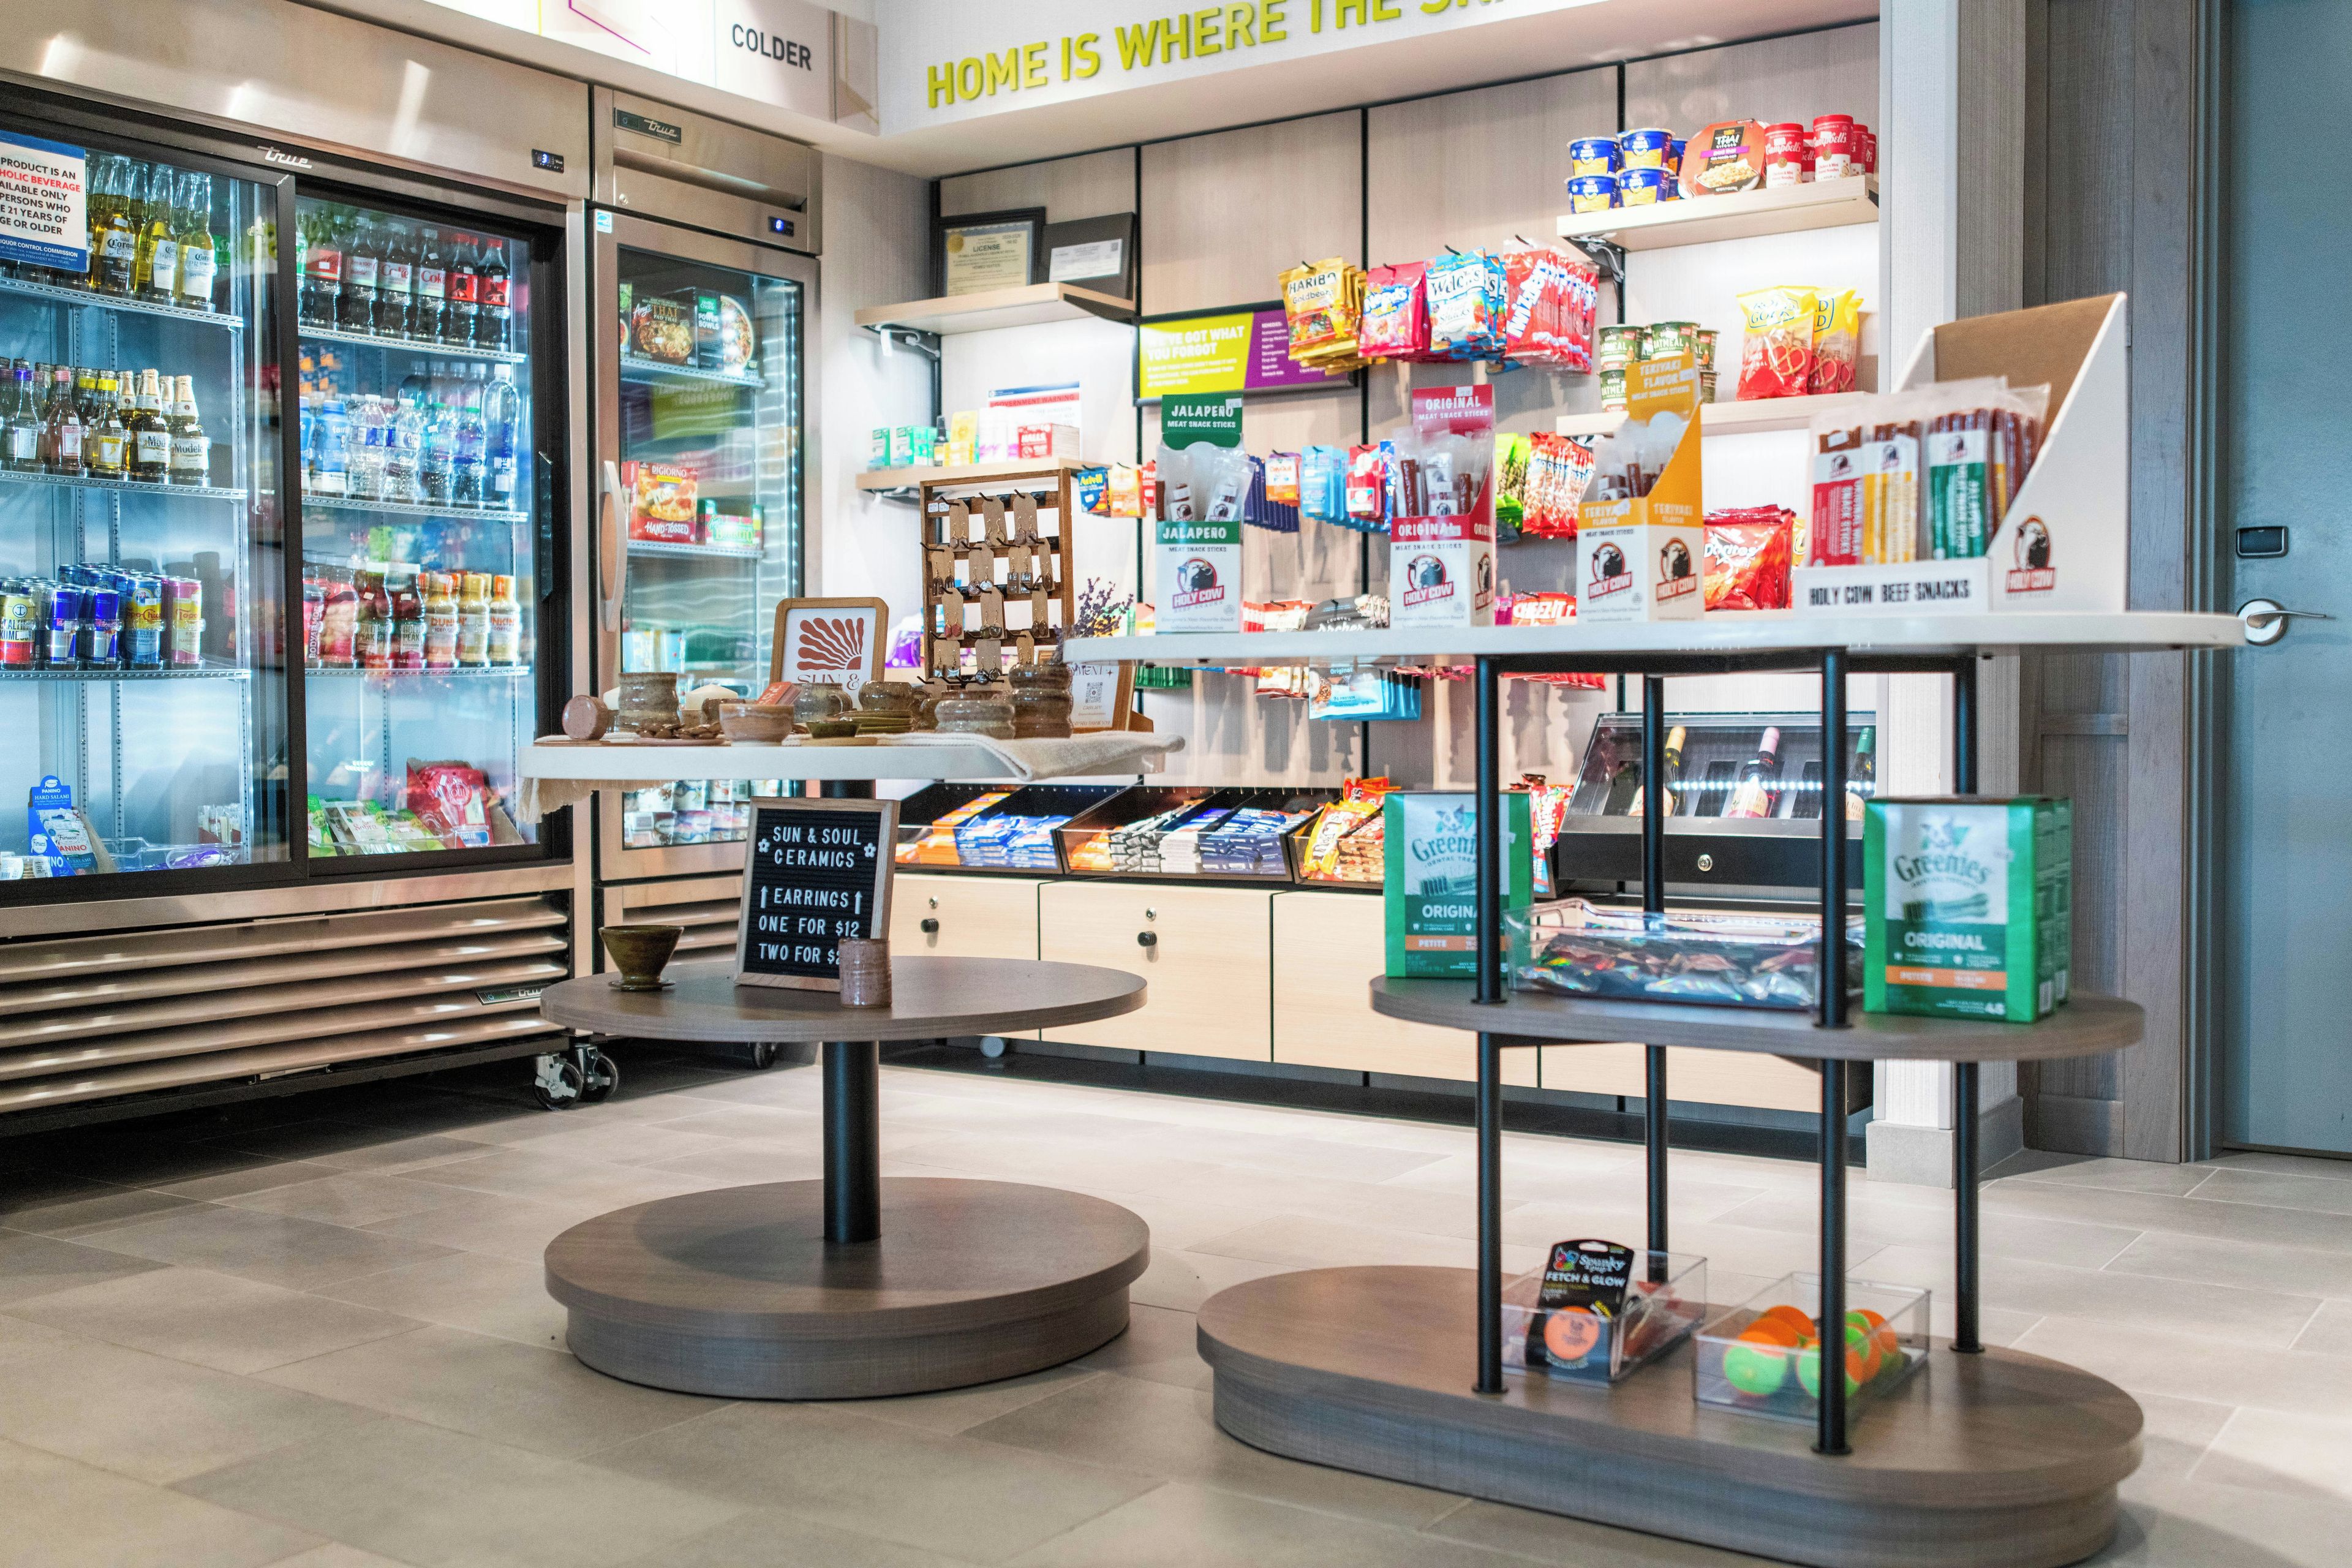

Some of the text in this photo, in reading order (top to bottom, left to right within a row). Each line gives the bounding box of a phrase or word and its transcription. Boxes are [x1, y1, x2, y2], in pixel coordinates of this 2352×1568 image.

[732, 23, 812, 72] COLDER
[927, 41, 1047, 108] HOME
[1060, 33, 1101, 81] IS
[1115, 2, 1287, 71] WHERE
[1715, 135, 1740, 145] THAI
[257, 145, 312, 169] true
[1, 157, 76, 179] PRODUCT IS AN
[31, 176, 80, 192] BEVERAGE
[0, 193, 70, 213] PERSONS WHO
[41, 189, 68, 201] ONLY
[20, 208, 52, 222] YEARS
[55, 215, 67, 224] OF
[14, 219, 28, 229] OR
[30, 223, 62, 235] OLDER
[18, 243, 43, 252] CONTROL
[44, 247, 78, 258] COMMISSION
[1430, 268, 1481, 296] Welc's
[698, 313, 718, 323] POWER
[698, 321, 719, 331] BOWLS
[1185, 330, 1207, 343] GOT
[1210, 326, 1245, 341] WHAT
[1147, 342, 1218, 361] YOU FORGOT
[993, 394, 1074, 407] GOVERNMENT WARNING
[1426, 396, 1481, 411] ORIGINAL
[1171, 404, 1234, 418] JALAPEÑO
[1163, 526, 1227, 540] JALAPEÑO
[1398, 524, 1450, 537] ORIGINA
[1173, 587, 1224, 607] HOLY COW
[1404, 582, 1453, 605] HOLY COW
[1810, 579, 1970, 606] HOLY COW BEEF SNACKS
[402, 633, 420, 642] PEAK
[846, 673, 860, 690] &
[773, 826, 861, 845] SUN & SOUL
[1412, 832, 1476, 862] Greeni
[774, 849, 855, 869] CERAMICS
[1893, 853, 1989, 885] Greenies
[774, 888, 849, 908] EARRINGS
[1422, 905, 1477, 919] ORIGIN
[758, 915, 860, 937] ONE FOR $12
[1904, 932, 1988, 952] ORIGINAL
[758, 943, 789, 961] TWO
[794, 946, 821, 963] FOR
[1545, 1271, 1626, 1287] FETCH & GLOW
